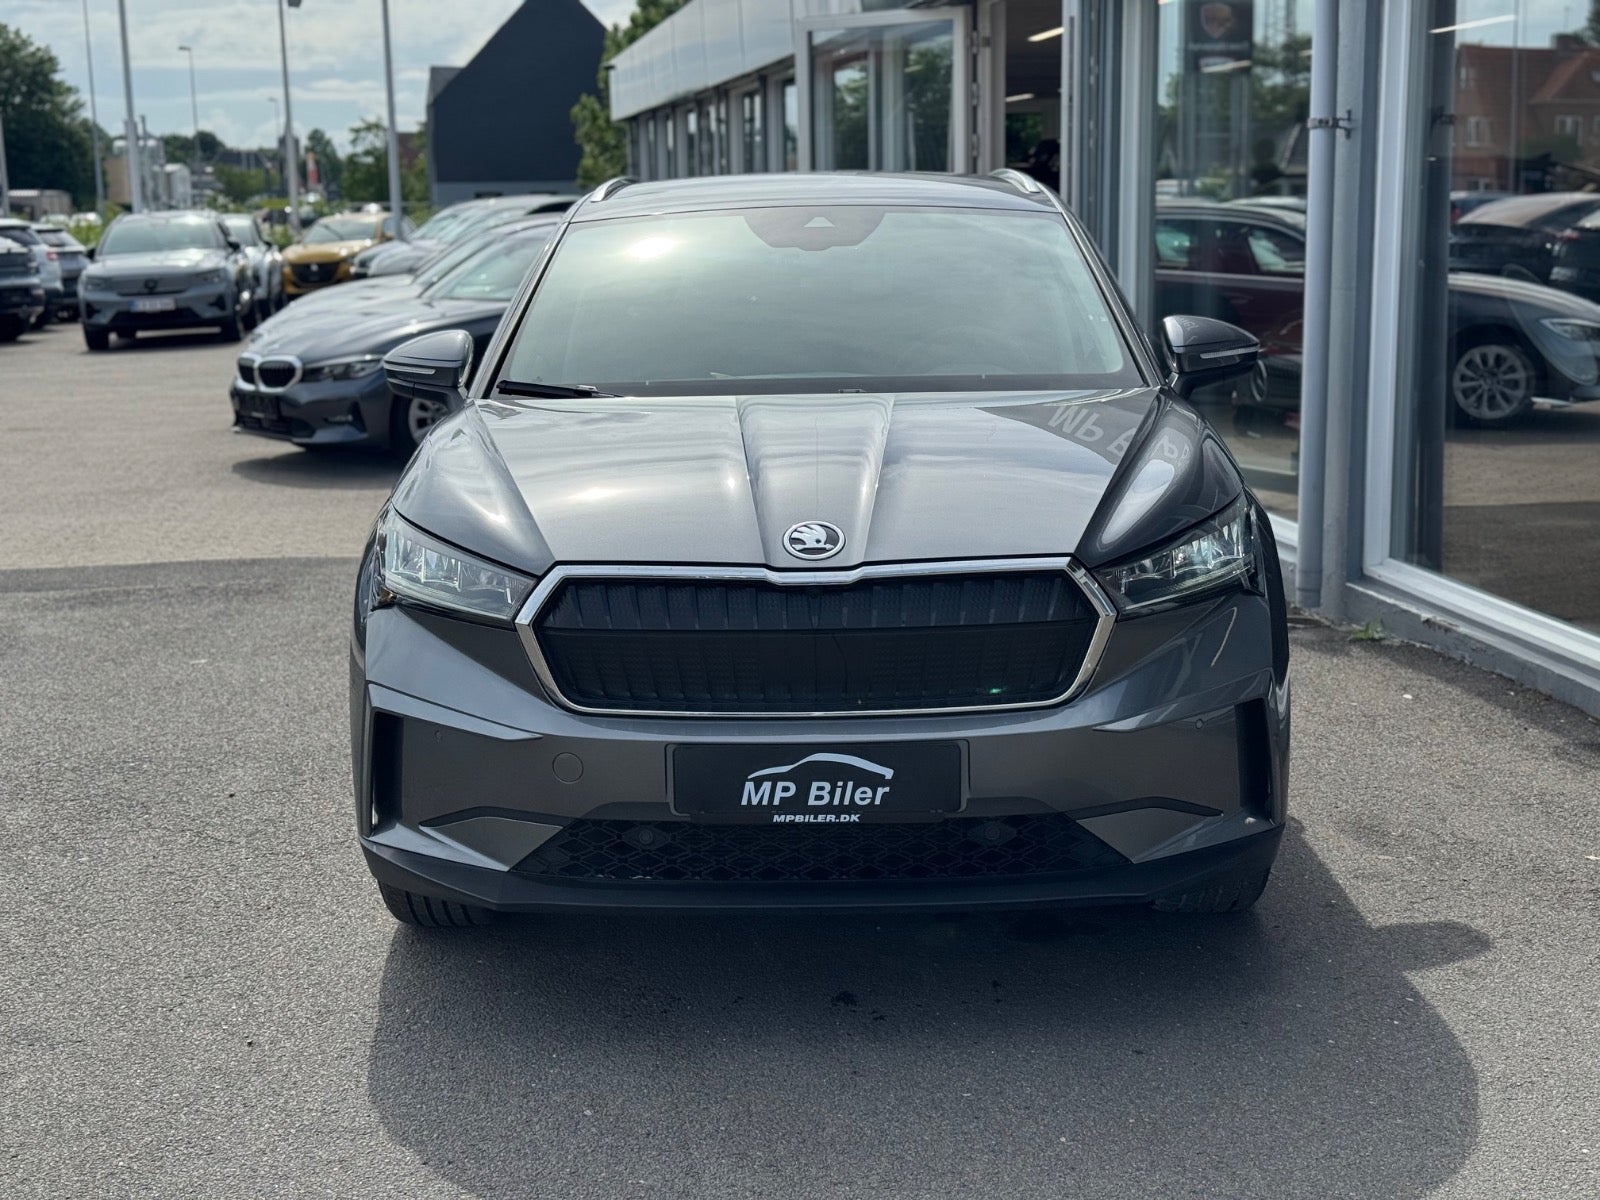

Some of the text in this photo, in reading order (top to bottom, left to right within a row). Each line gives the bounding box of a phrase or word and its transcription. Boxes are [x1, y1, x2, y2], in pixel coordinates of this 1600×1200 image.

[740, 781, 890, 806] MP Biler
[772, 814, 861, 823] MPBILER.DK
